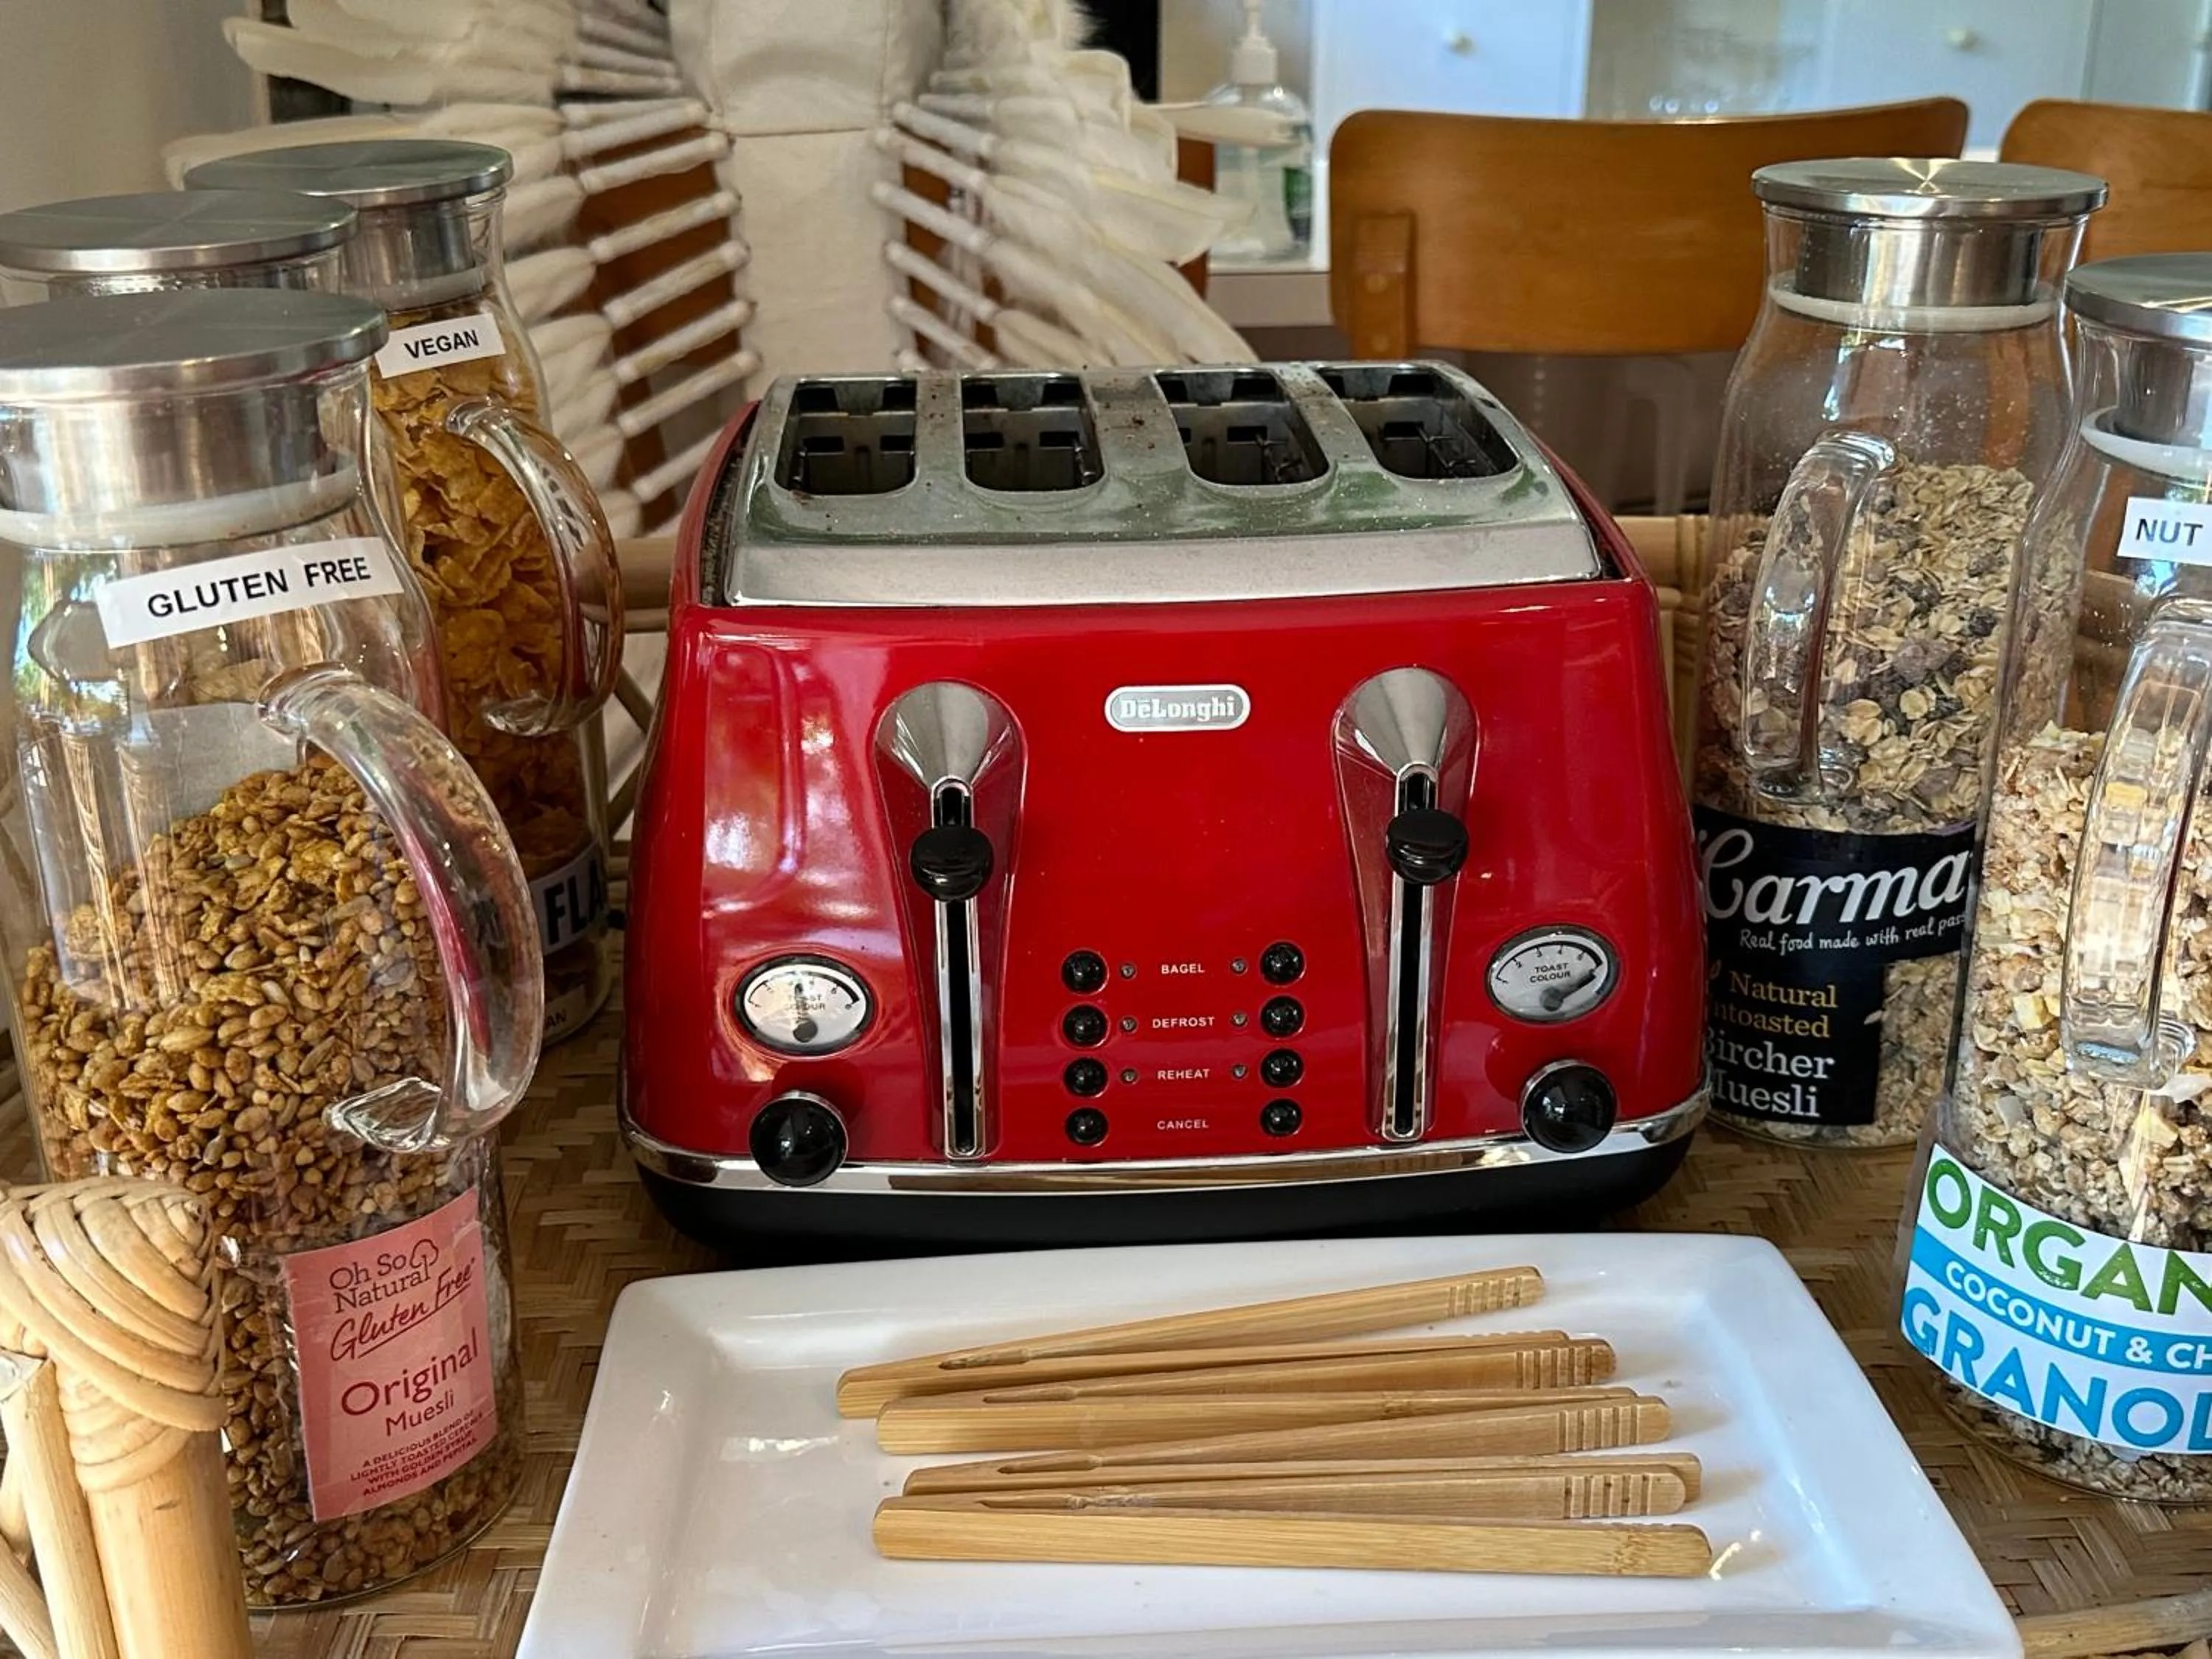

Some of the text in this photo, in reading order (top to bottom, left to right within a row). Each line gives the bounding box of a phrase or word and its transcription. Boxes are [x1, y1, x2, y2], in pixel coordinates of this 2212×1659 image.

[404, 330, 479, 360] VEGAN
[2135, 518, 2203, 546] NUT
[147, 556, 372, 618] GLUTEN FREE
[1703, 829, 1972, 925] Carma
[1740, 929, 1775, 950] Real
[1779, 932, 1813, 956] food
[1819, 931, 1860, 950] made
[1865, 926, 1899, 946] with
[1905, 918, 1935, 940] real
[1161, 963, 1206, 975] BAGEL
[1529, 971, 1571, 983] COLOUR
[1534, 962, 1569, 973] TOAST
[1729, 970, 1839, 1008] Natural
[1152, 1017, 1216, 1029] DEFROST
[1712, 1001, 1831, 1038] ntoasted
[1157, 1068, 1210, 1080] REHEAT
[1157, 1119, 1209, 1130] CANCEL
[330, 1253, 407, 1290] Oh So
[333, 1255, 431, 1314] Natural
[330, 1263, 473, 1362] Gluten Free
[1945, 1261, 2116, 1356] COCONUT
[2124, 1336, 2153, 1363] &
[341, 1326, 478, 1416] Original
[386, 1389, 454, 1437] Muesli
[350, 1459, 397, 1481] LIGHTLY
[400, 1436, 447, 1464] TOASTED
[373, 1437, 431, 1465] DELICIOUS
[433, 1417, 462, 1441] BLEND
[363, 1471, 418, 1496] ALMONDS
[420, 1459, 442, 1475] AND
[368, 1468, 400, 1484] WITH
[402, 1447, 443, 1473] GOLDEN
